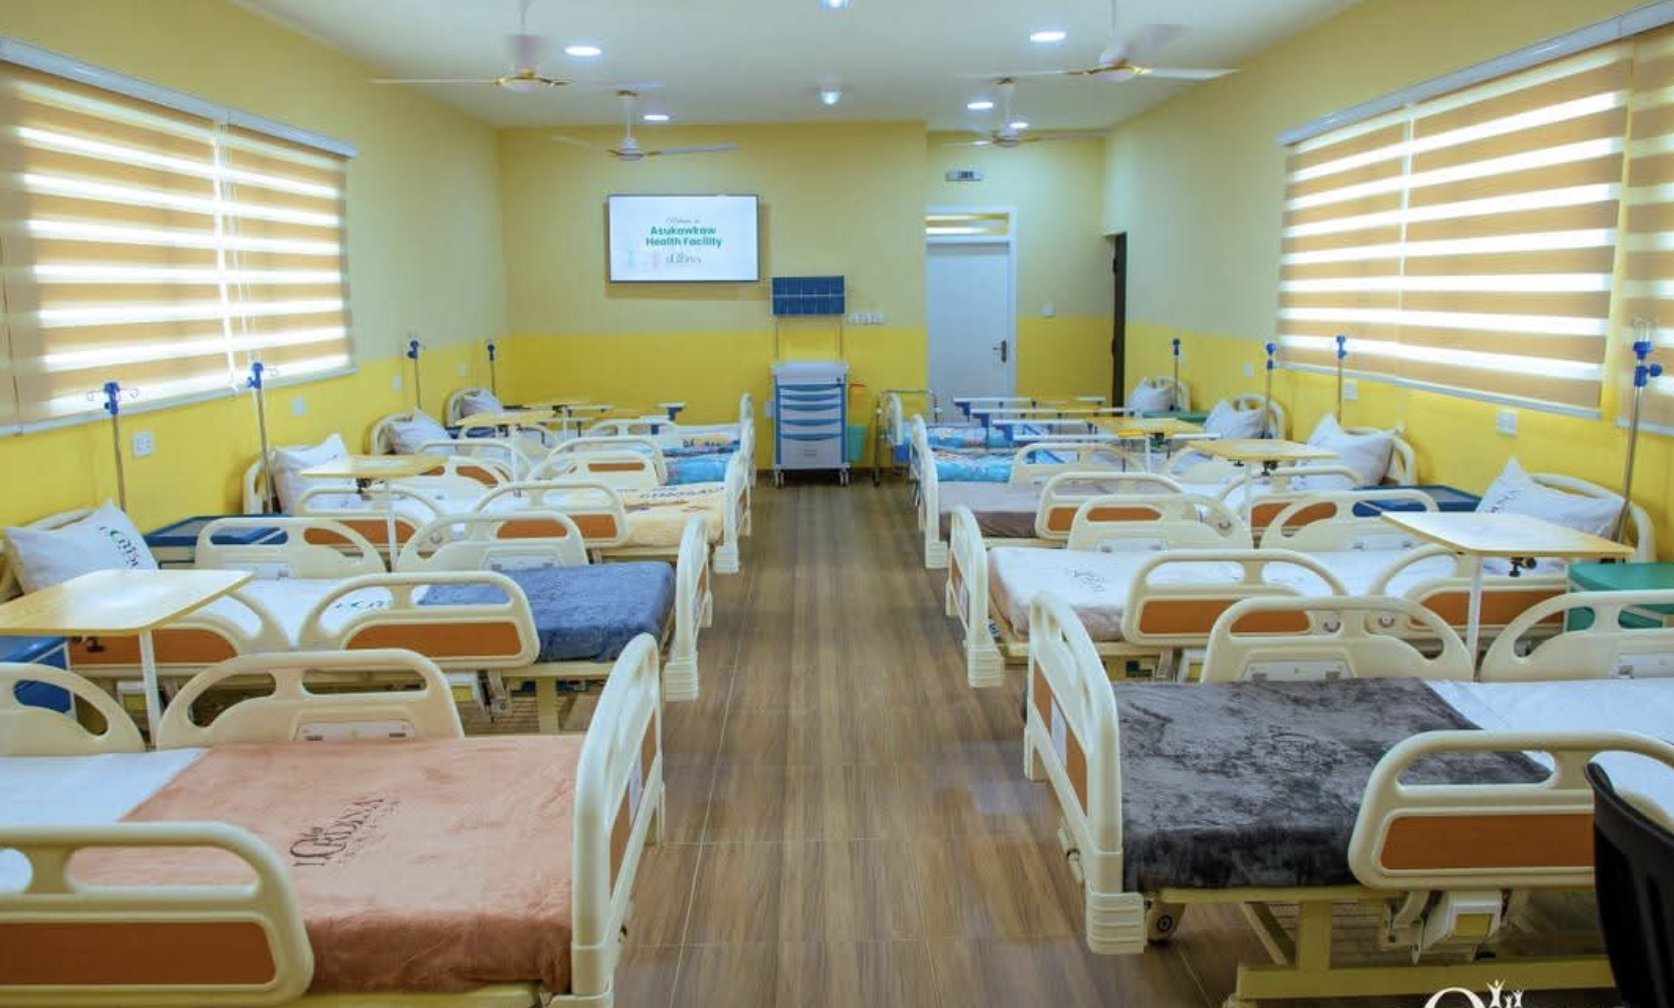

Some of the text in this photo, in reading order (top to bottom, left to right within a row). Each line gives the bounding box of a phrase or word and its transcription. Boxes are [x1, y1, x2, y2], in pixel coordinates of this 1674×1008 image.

[650, 225, 717, 236] Asukawkaw
[646, 237, 723, 248] Health Facility
